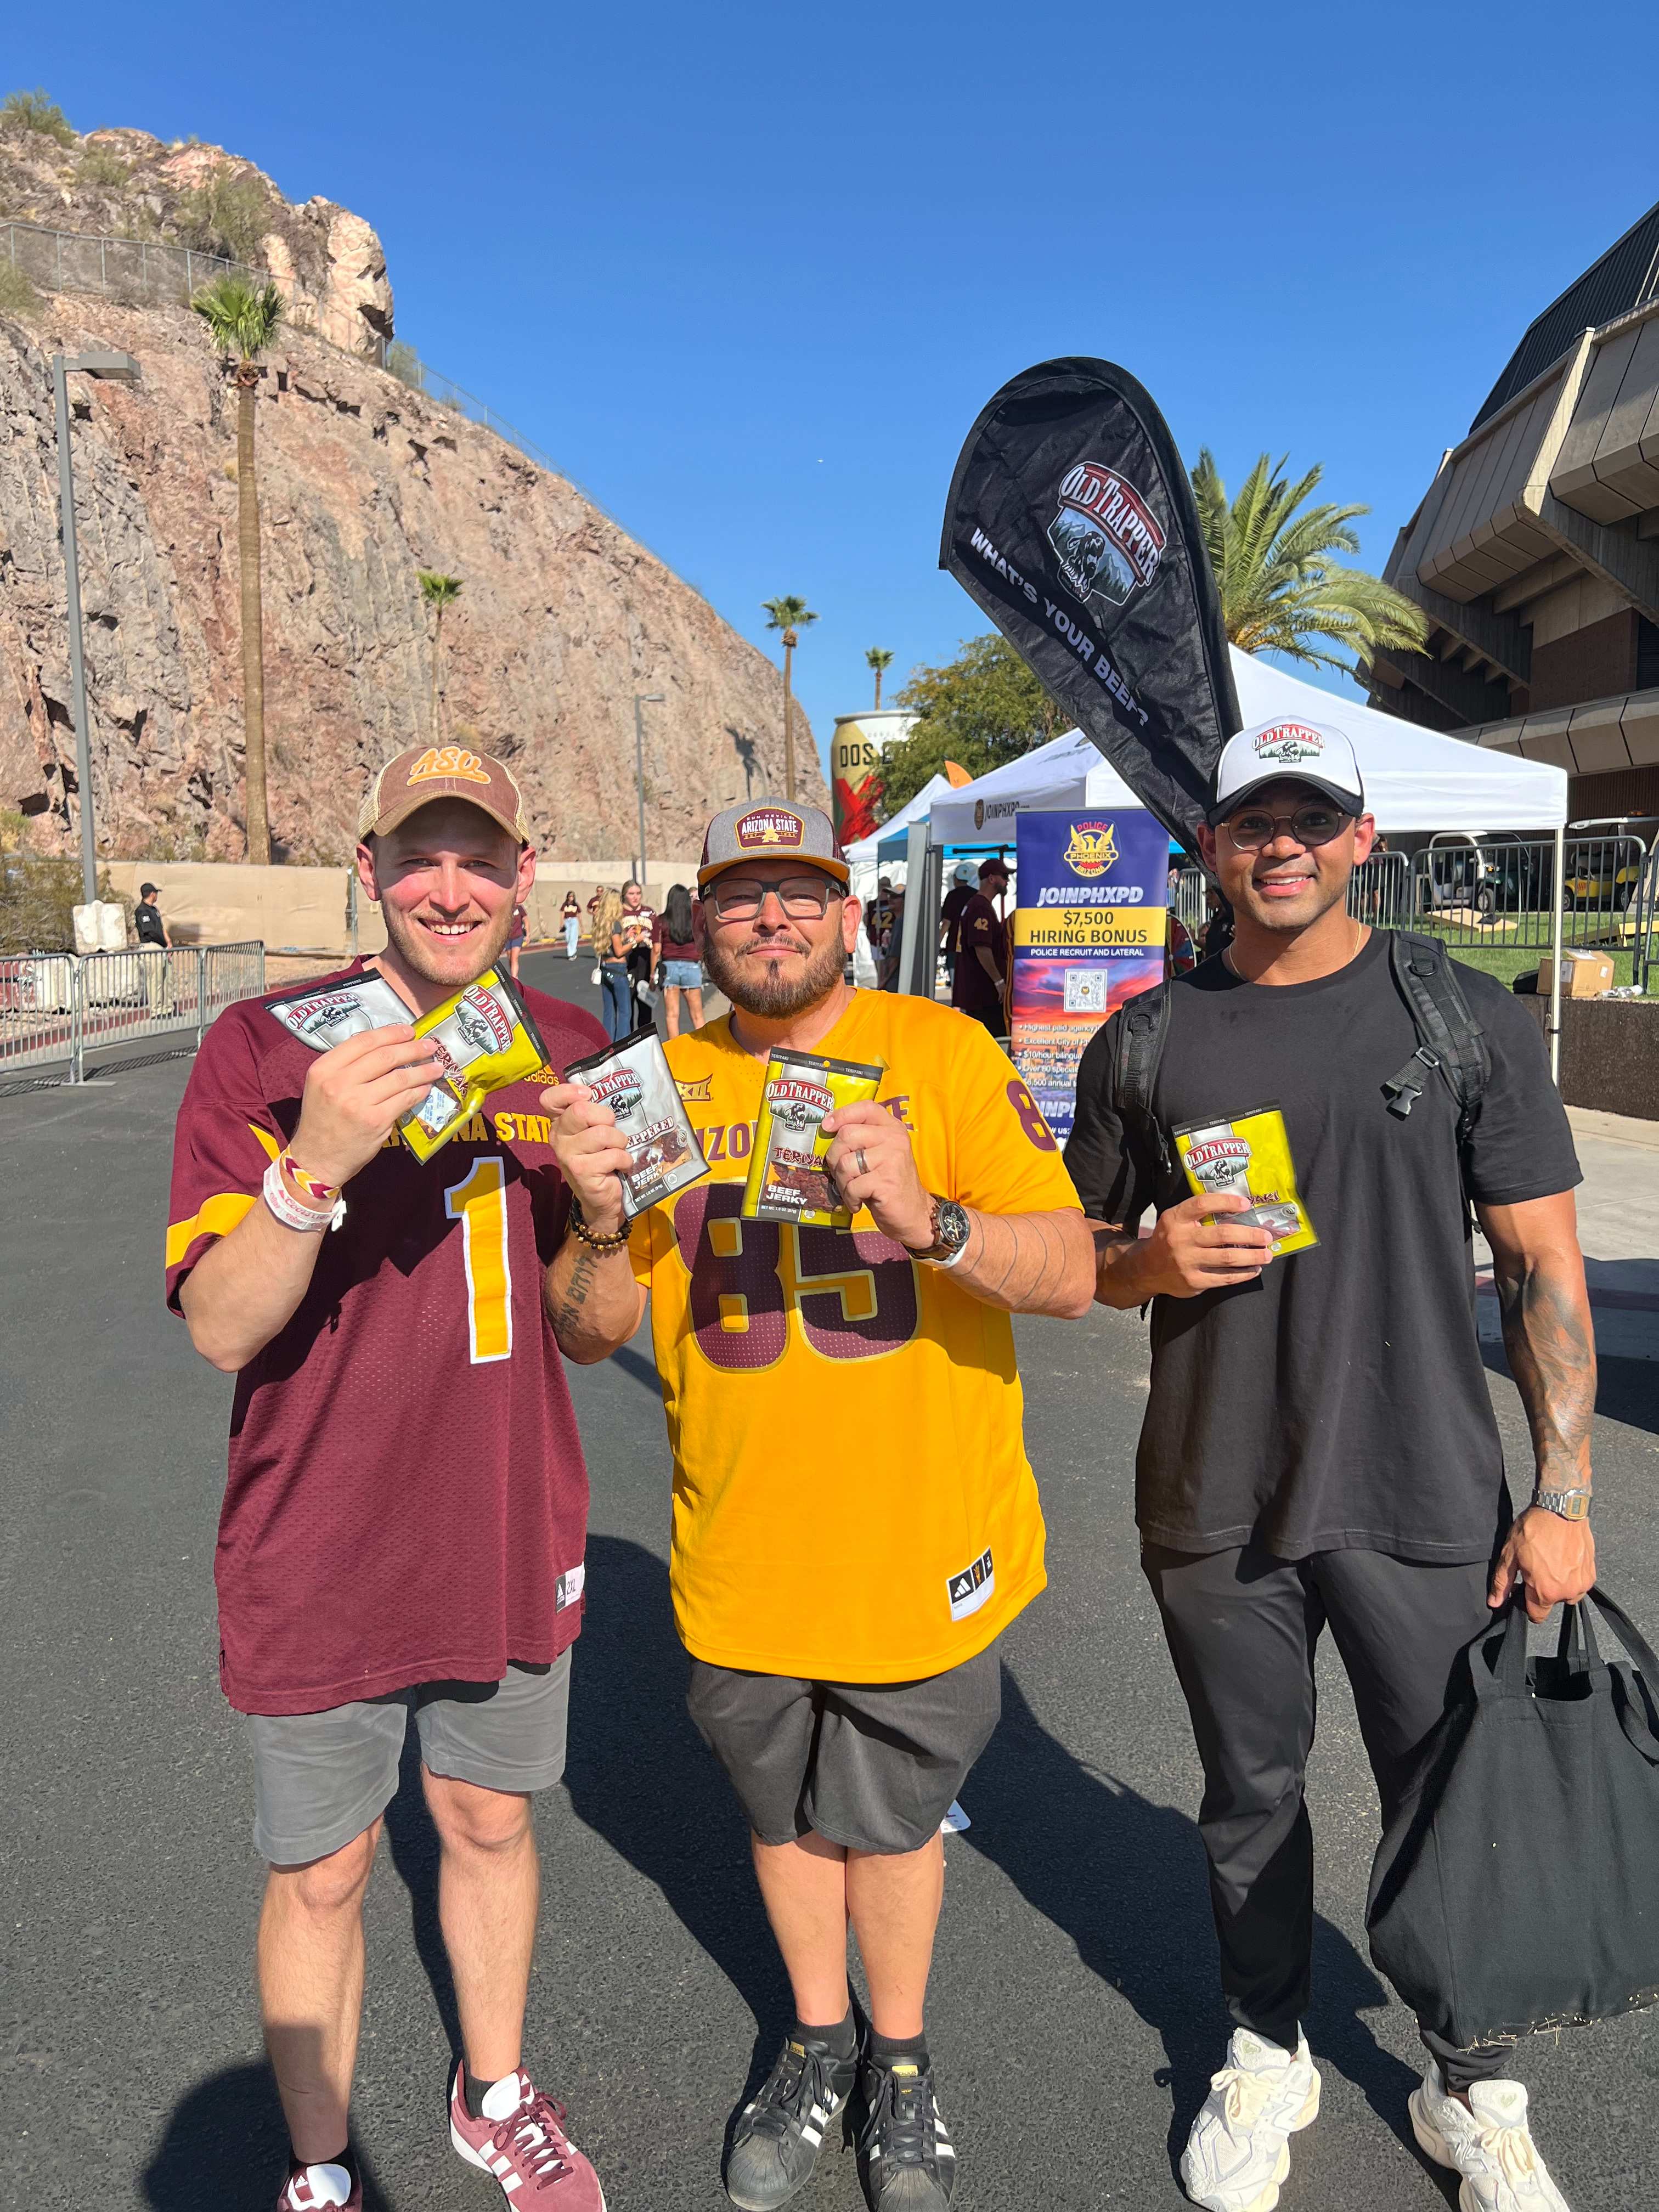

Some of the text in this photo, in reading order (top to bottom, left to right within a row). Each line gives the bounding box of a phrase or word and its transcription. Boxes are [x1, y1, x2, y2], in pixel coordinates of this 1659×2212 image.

[1060, 465, 1101, 505] OLD
[1092, 477, 1160, 585] TRAPPER
[970, 527, 1038, 603] WHAT'S
[1043, 597, 1095, 662] YOUR
[1093, 654, 1149, 727] BEEF?
[1252, 725, 1325, 749] OLD TRAPPER
[408, 746, 488, 782] ASU
[742, 818, 798, 834] ARIZONA STATE
[1076, 821, 1108, 832] POLICE
[1076, 865, 1105, 875] ARIZONA
[1036, 886, 1144, 907] JOINPHXPD
[974, 917, 989, 932] 42
[1063, 910, 1114, 928] $7,500
[1030, 929, 1148, 943] HIRING BONUS
[1059, 948, 1092, 956] RECRUIT
[287, 993, 358, 1029] OLD TRAPPER
[465, 986, 488, 1007] OLD
[483, 998, 511, 1052] TRAPPER
[771, 1053, 789, 1061] TERIYAKI
[1023, 1051, 1082, 1060] $10/hour bilingua
[595, 1071, 642, 1101] TRAPPER
[767, 1081, 833, 1110] OLD TRAPPER
[1007, 1078, 1058, 1152] 8
[494, 1111, 552, 1144] STAT
[772, 1145, 823, 1167] TERIYA
[1185, 1142, 1251, 1168] OLD TRAPPER
[631, 1163, 658, 1183] BEEF
[634, 1165, 663, 1189] JERKY
[766, 1192, 808, 1205] JERKY
[768, 1185, 801, 1197] BEEF
[444, 1156, 513, 1365] 1
[672, 1175, 922, 1374] 85
[566, 1578, 576, 1595] 2XL
